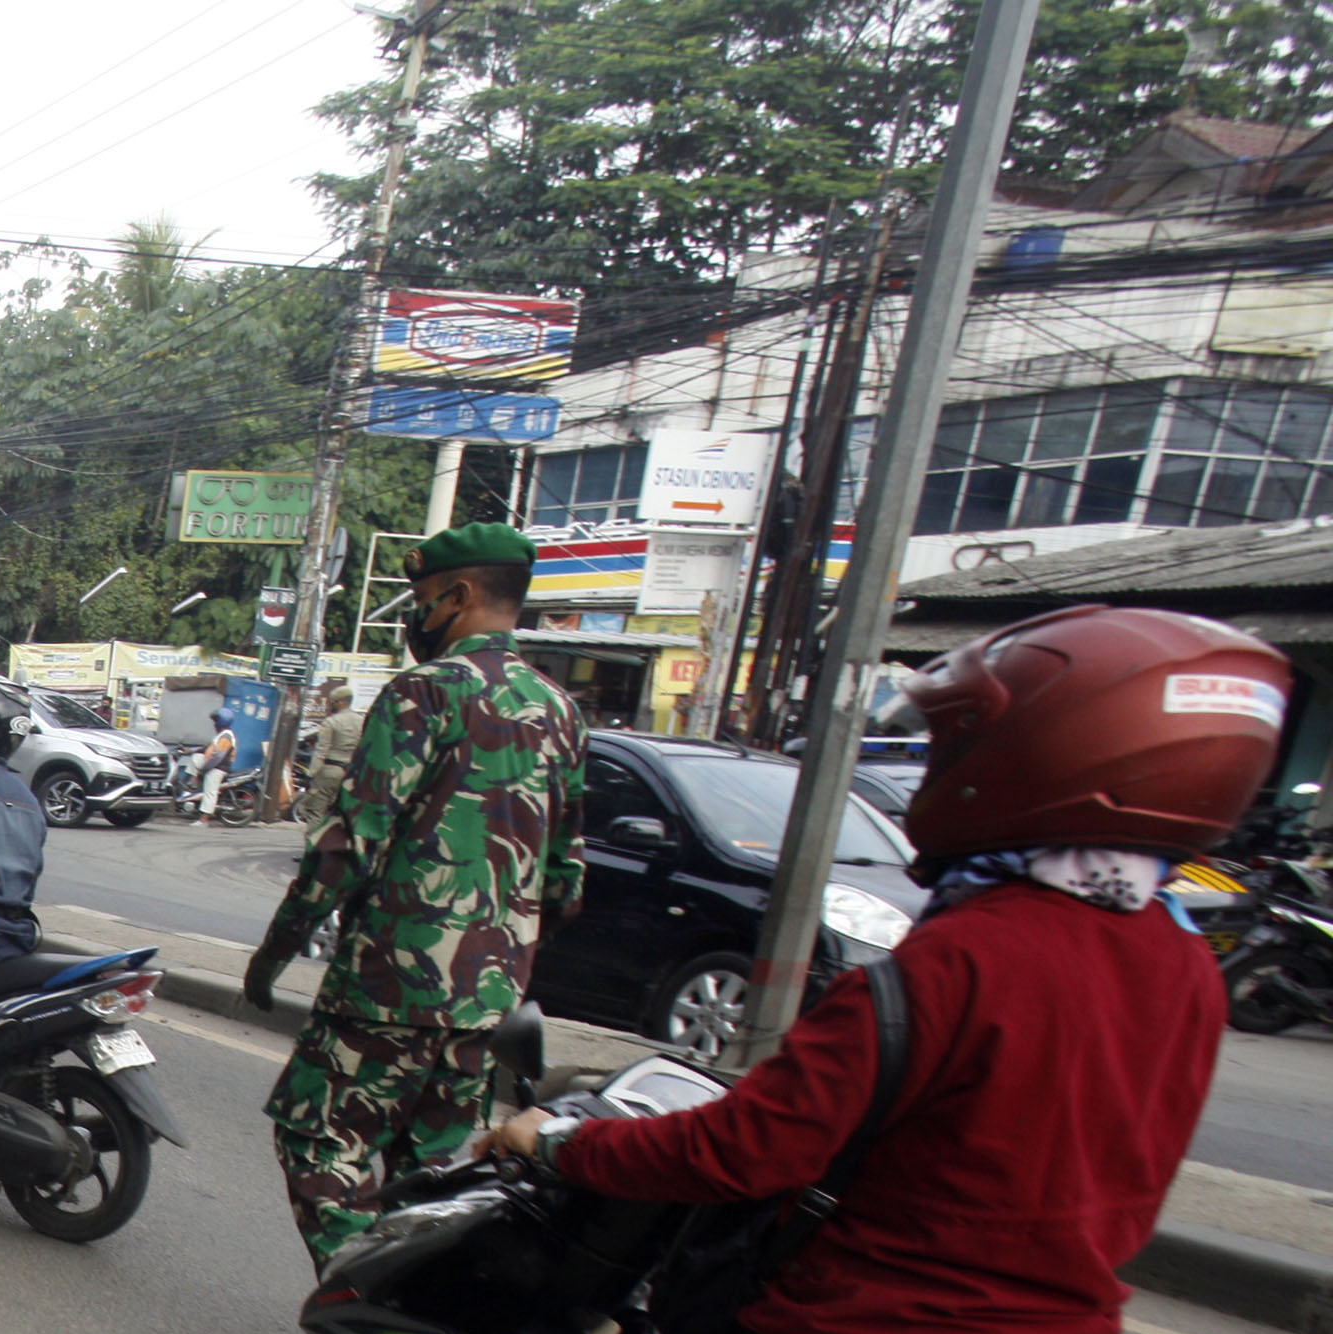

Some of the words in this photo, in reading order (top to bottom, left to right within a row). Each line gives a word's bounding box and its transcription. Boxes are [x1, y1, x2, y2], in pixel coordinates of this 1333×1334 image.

[266, 481, 312, 501] OPT
[653, 467, 699, 487] STASIUN
[701, 470, 756, 491] CIBINONG
[185, 510, 309, 538] FORTUN
